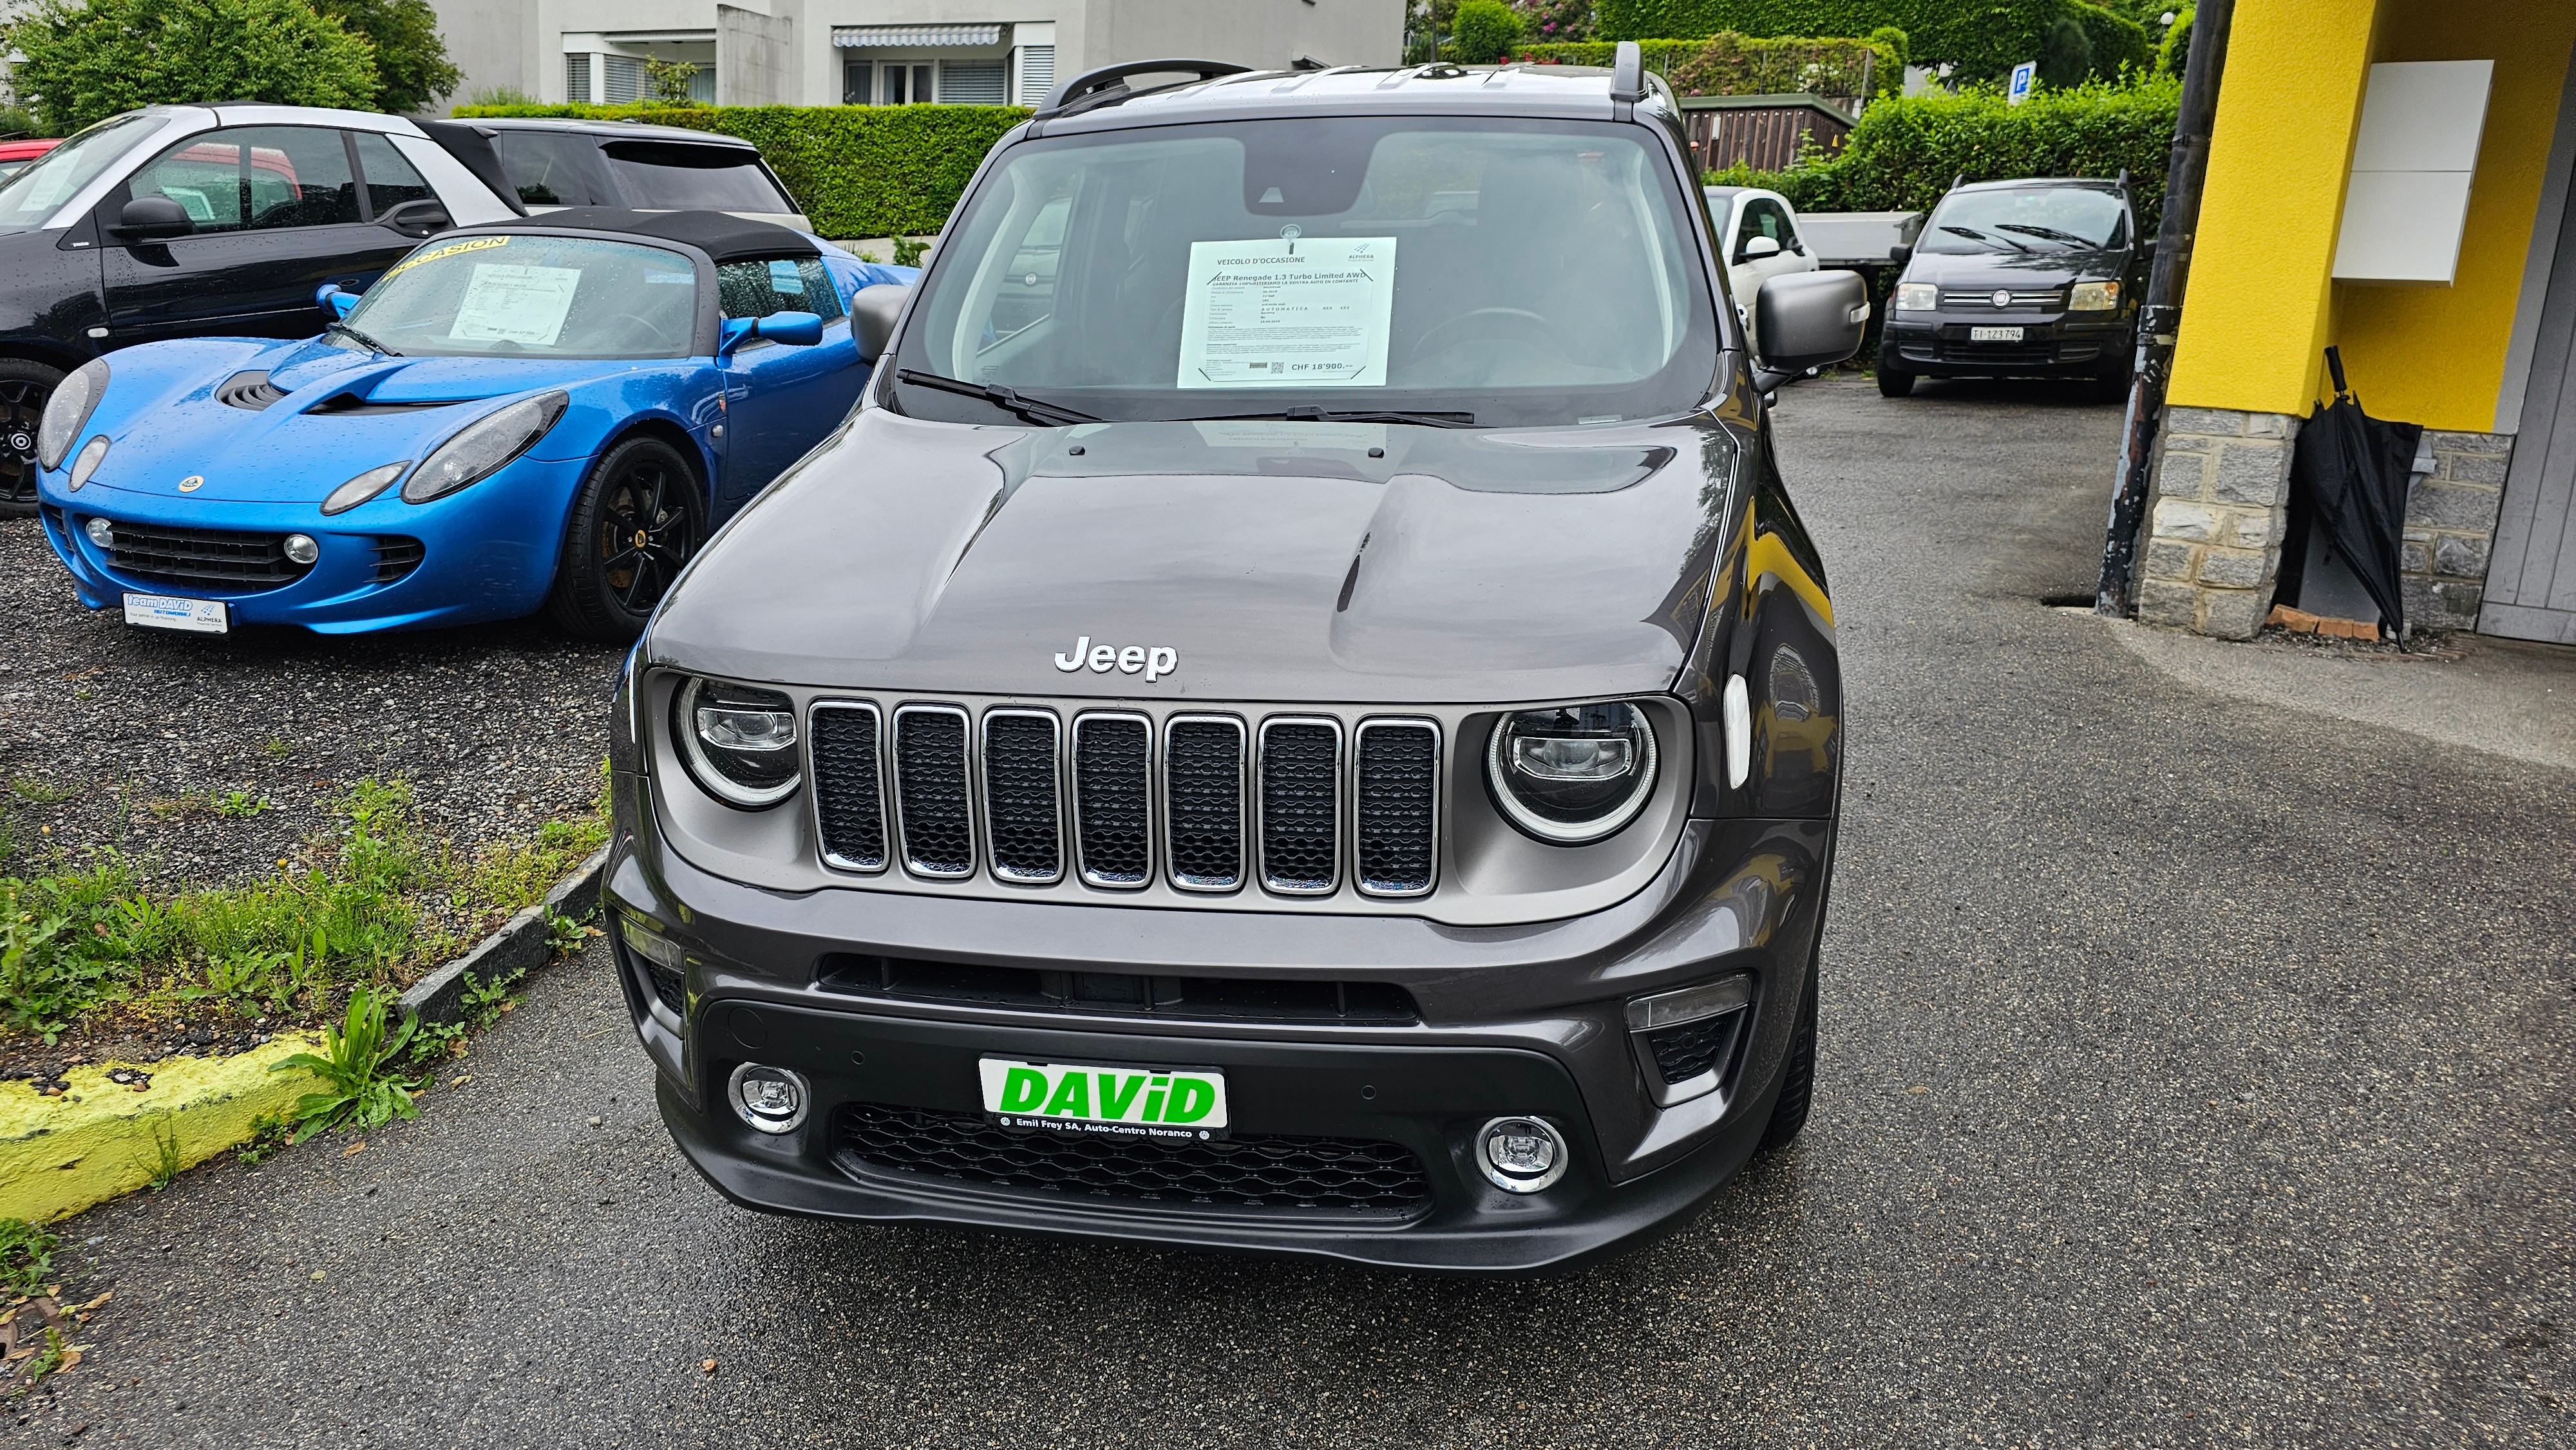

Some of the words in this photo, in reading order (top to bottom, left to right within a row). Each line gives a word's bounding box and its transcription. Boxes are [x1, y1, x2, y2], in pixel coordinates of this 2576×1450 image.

[2016, 70, 2028, 92] P
[128, 594, 158, 608] team
[158, 598, 193, 610] DAViD
[1054, 636, 1179, 683] Jeep
[999, 1067, 1216, 1124] DAViD
[1016, 1118, 1039, 1127] Emil
[1041, 1120, 1063, 1130] Frey
[1065, 1122, 1082, 1131] SA,
[1084, 1124, 1146, 1135] Auto-Centro
[1149, 1128, 1193, 1138] Noranco
